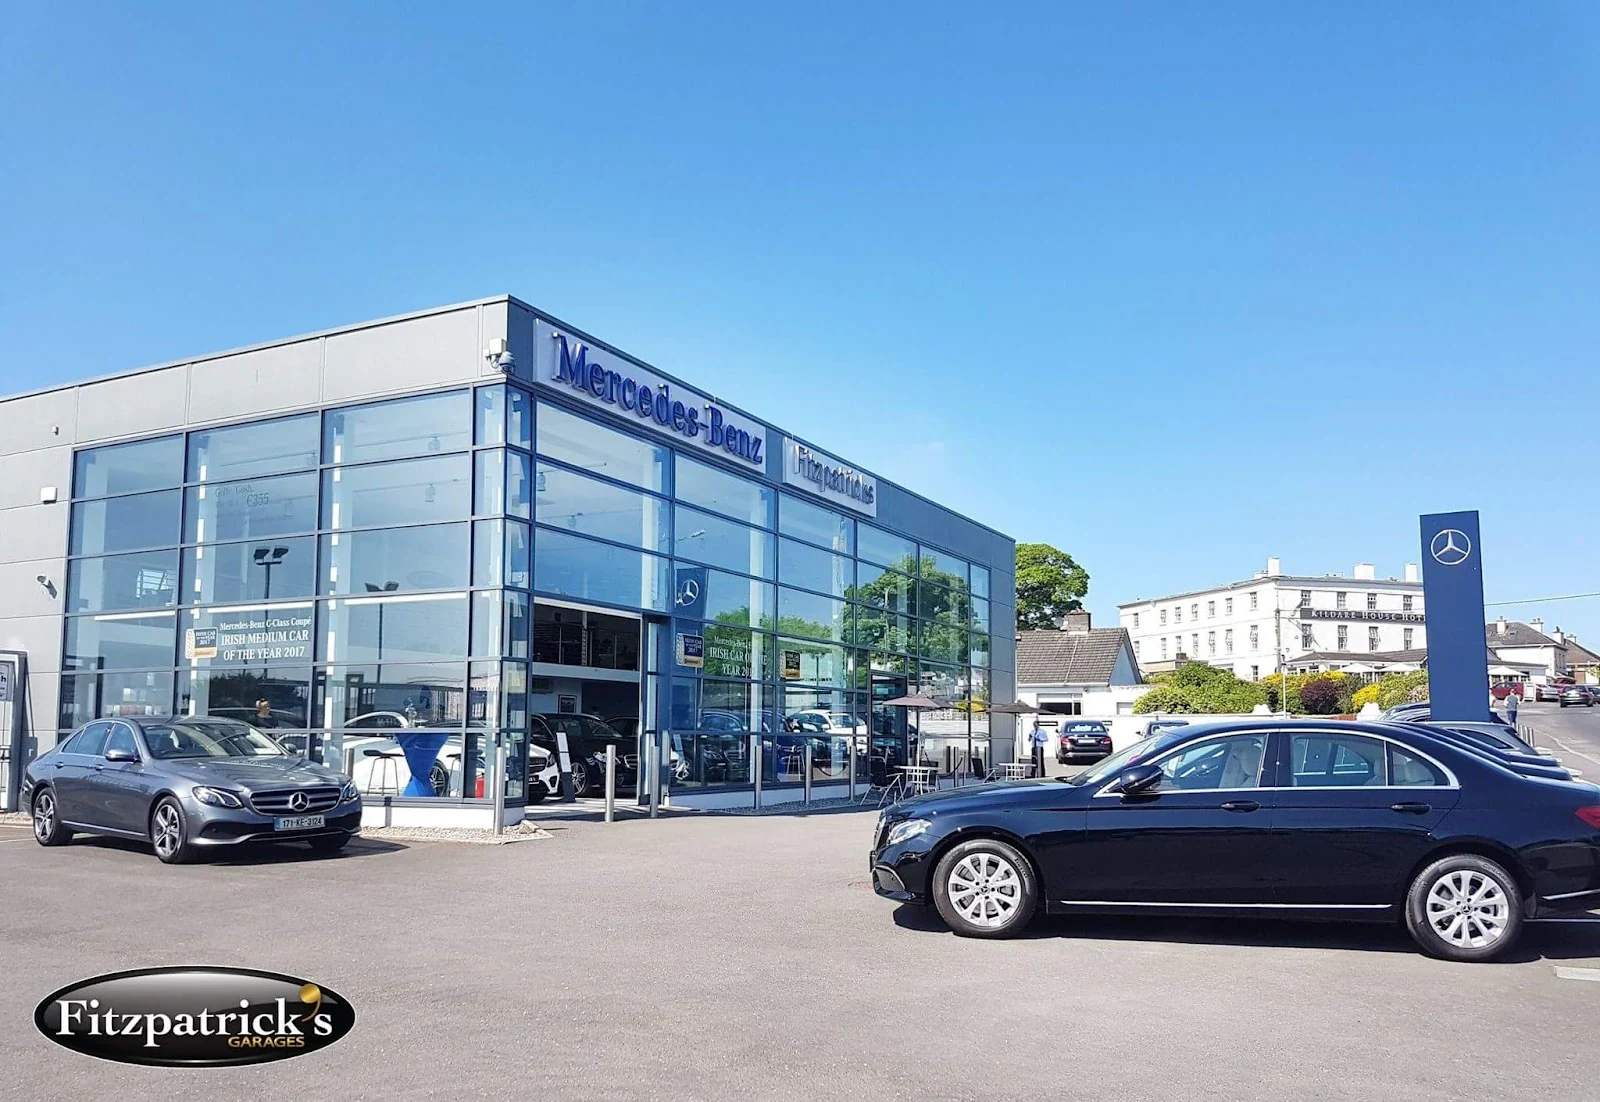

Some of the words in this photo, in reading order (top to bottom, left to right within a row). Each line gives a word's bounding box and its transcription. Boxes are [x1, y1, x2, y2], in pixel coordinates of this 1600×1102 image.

[551, 332, 763, 465] Mercedes-Benz
[793, 445, 874, 505] Fitzpatricks
[1311, 611, 1356, 619] KILDARE
[1362, 612, 1396, 620] HOUSE
[220, 620, 265, 631] Mercedes-Benz
[266, 618, 290, 628] C-Class
[291, 616, 312, 628] Coupé
[221, 634, 247, 645] IRISH
[248, 631, 288, 644] MEDIUM
[289, 630, 309, 641] CAR
[223, 650, 235, 661] OF
[238, 649, 255, 660] THE
[257, 647, 282, 659] YEAR
[284, 646, 305, 658] 2017
[709, 647, 730, 660] IRISH
[730, 650, 744, 662] CAR
[722, 663, 740, 676] YEAR
[741, 666, 753, 677] 201
